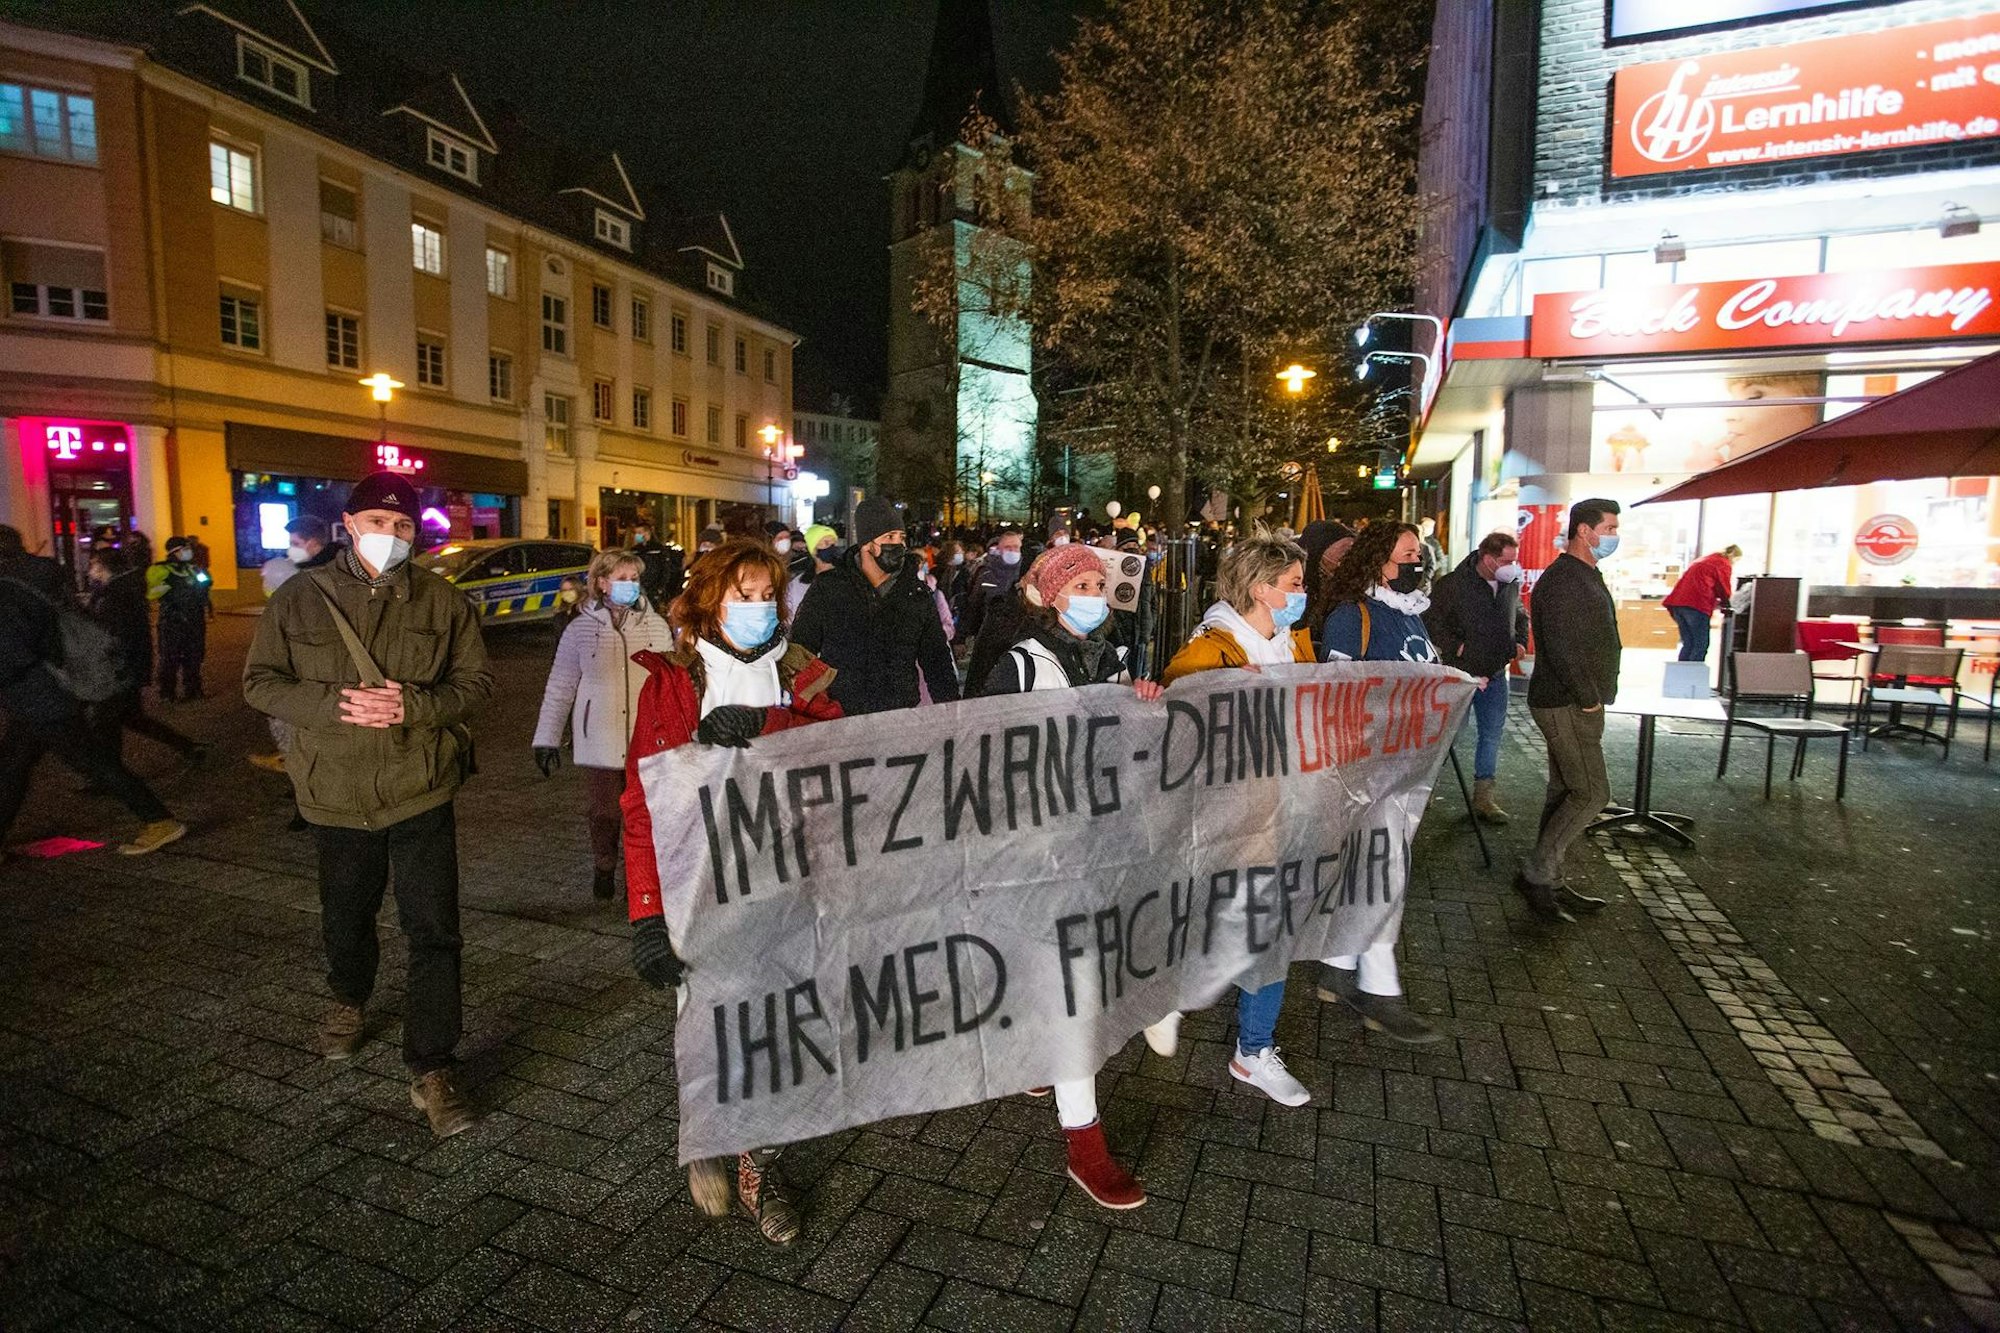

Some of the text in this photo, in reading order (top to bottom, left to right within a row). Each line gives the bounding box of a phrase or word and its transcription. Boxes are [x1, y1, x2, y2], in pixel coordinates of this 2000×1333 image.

[1721, 83, 1904, 134] Lernhilfe
[1706, 115, 1999, 165] www.intensiv-lernhilfe.de
[1716, 280, 1993, 337] Company
[1295, 678, 1384, 773] OHNE
[1382, 676, 1461, 755] UNS
[713, 827, 1409, 1104] IHR MED. FACHPERSNA
